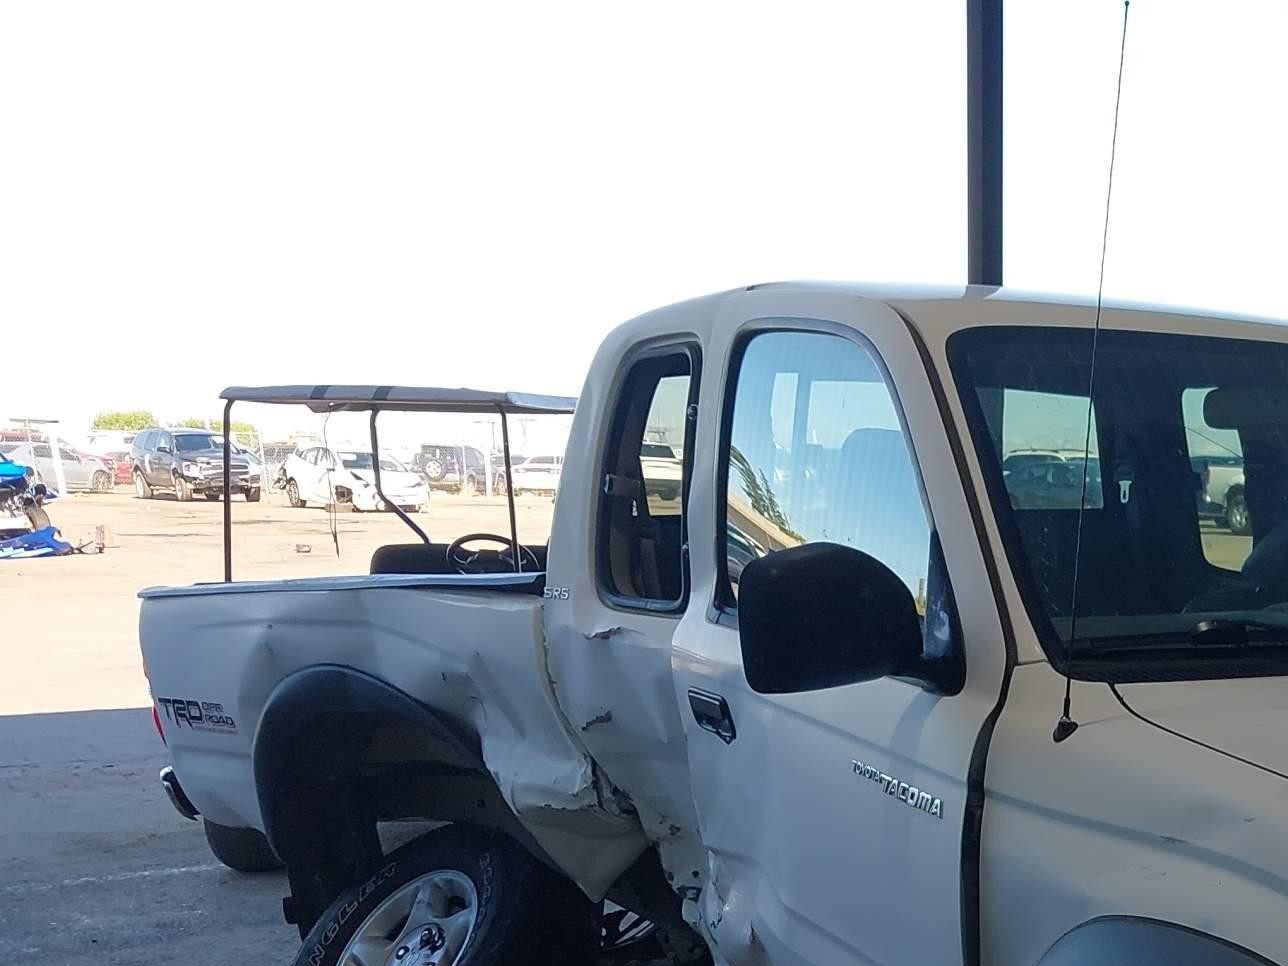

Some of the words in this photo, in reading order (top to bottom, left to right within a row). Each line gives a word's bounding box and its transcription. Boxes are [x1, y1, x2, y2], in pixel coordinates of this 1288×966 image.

[543, 586, 569, 600] SR5
[158, 697, 203, 728] TRD
[851, 759, 881, 783] TOYOTA
[880, 773, 944, 819] TACOMA
